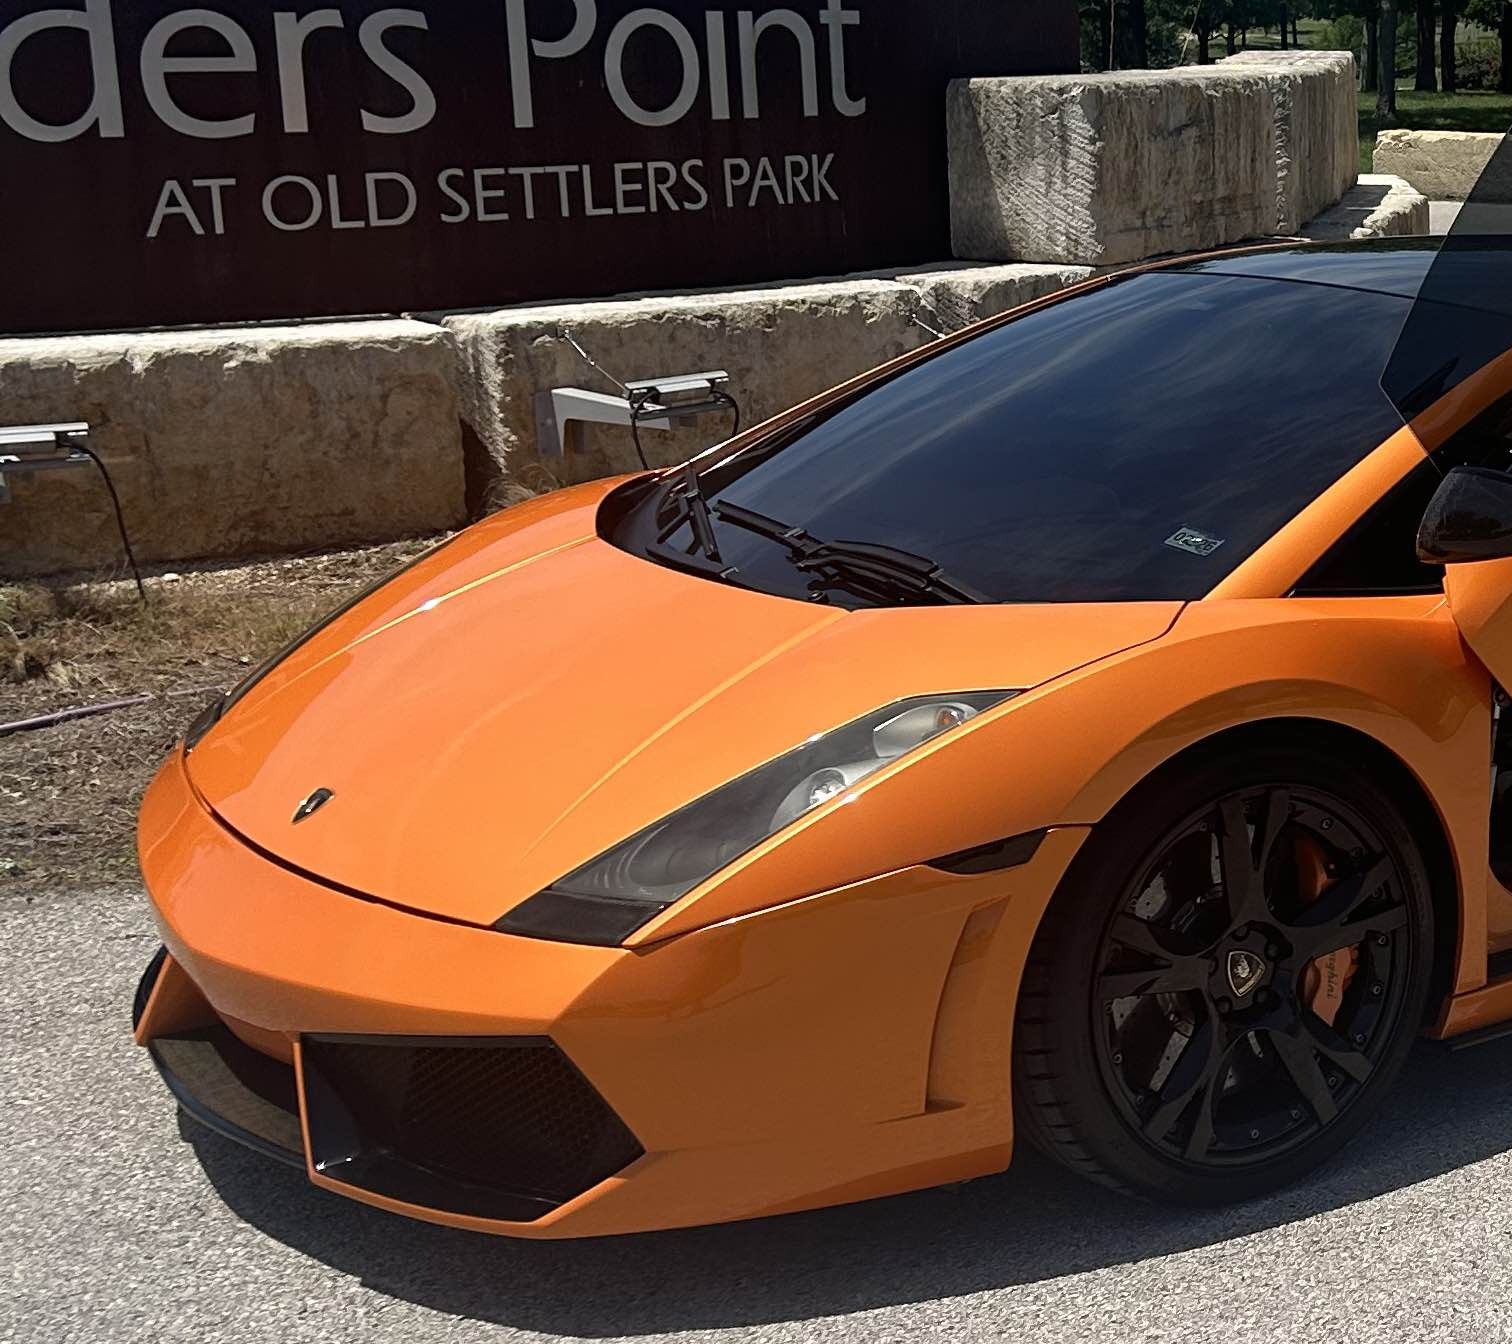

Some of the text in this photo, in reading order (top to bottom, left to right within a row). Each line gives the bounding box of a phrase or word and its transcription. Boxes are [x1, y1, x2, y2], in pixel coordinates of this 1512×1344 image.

[146, 153, 839, 238] AT OLD SETTLERS PARK
